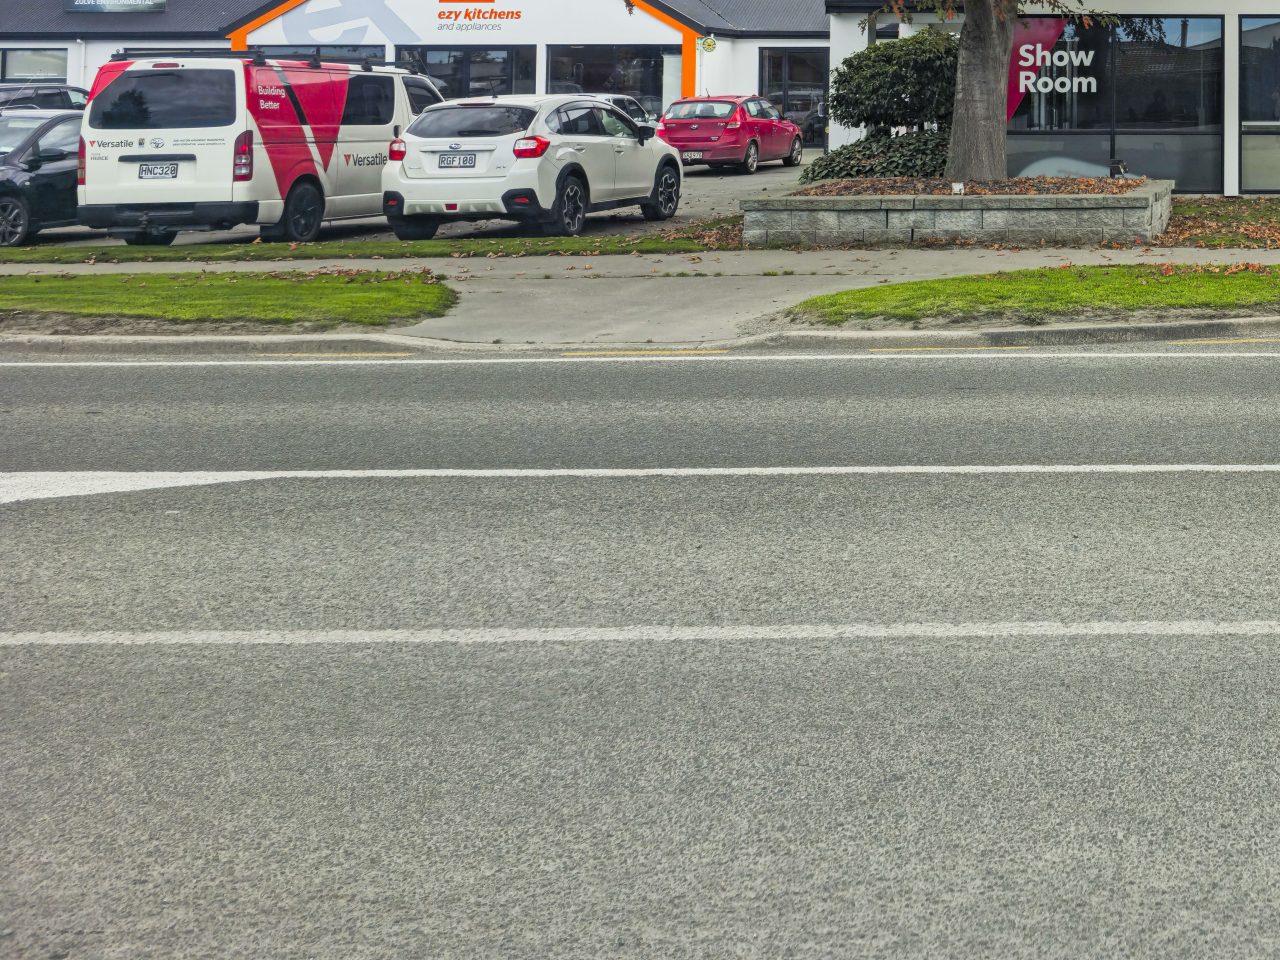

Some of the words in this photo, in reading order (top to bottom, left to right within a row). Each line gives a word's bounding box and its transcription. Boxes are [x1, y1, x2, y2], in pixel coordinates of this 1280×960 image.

[437, 10, 465, 21] ezy
[464, 8, 522, 20] kitchens
[437, 22, 454, 31] and
[455, 22, 502, 32] appliances
[1018, 43, 1096, 67] Show
[1019, 71, 1097, 93] Room
[258, 86, 286, 98] Building
[260, 100, 280, 109] Better
[97, 139, 134, 148] Versatile
[352, 153, 388, 167] Versatile
[440, 156, 474, 166] RGF108
[140, 165, 176, 176] HNC320
